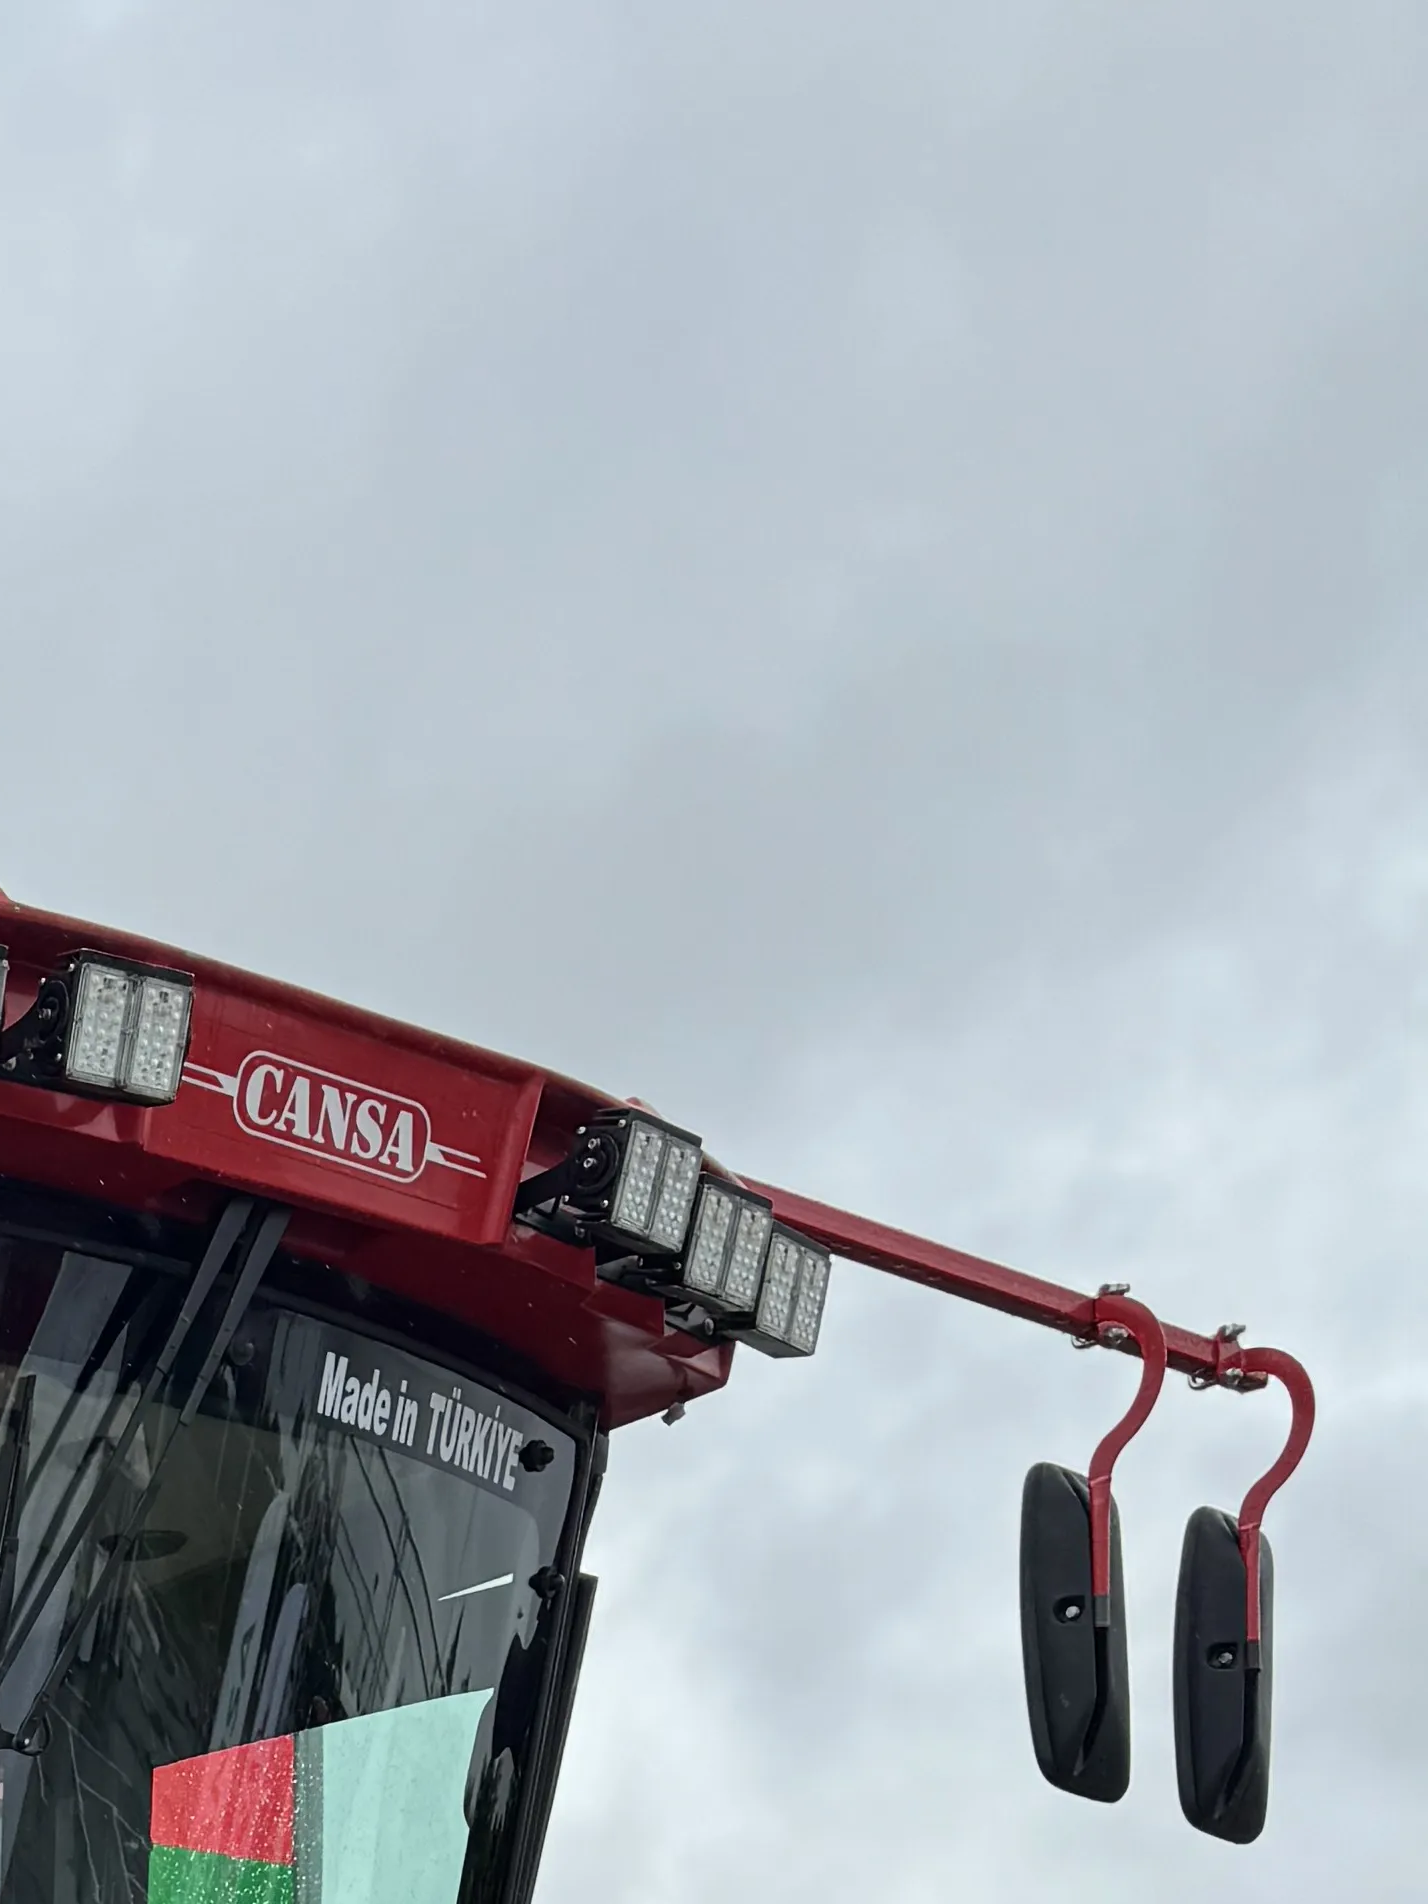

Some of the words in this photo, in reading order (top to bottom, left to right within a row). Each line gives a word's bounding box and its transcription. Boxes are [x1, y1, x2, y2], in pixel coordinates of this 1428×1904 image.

[246, 1064, 414, 1172] CANSA
[317, 1351, 391, 1436] Made
[392, 1380, 418, 1447] in
[426, 1387, 524, 1491] TÜRKİYE
